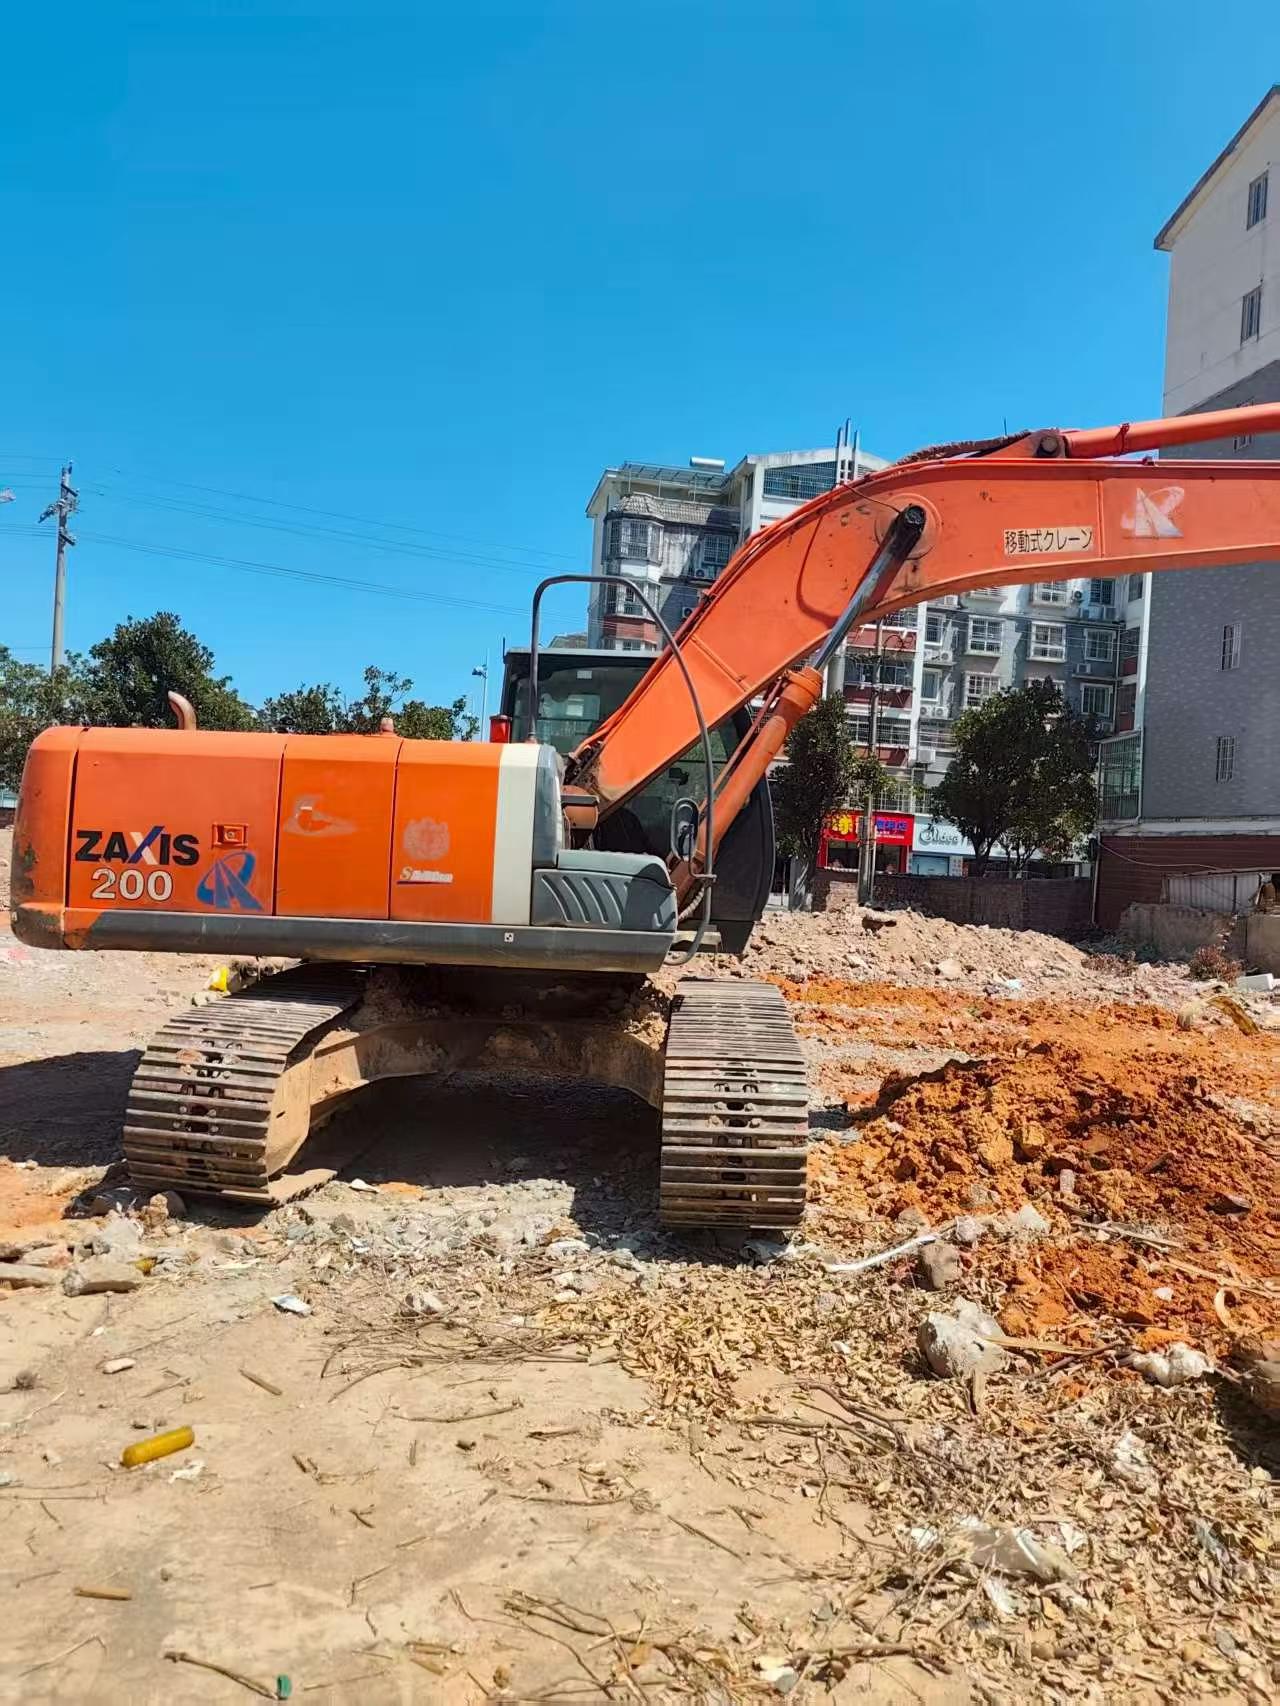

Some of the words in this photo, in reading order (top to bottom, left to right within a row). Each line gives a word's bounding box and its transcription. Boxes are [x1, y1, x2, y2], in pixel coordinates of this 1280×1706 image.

[1005, 528, 1093, 554] 移動式クレーン
[75, 825, 200, 866] ZAXIS
[91, 867, 174, 902] 200
